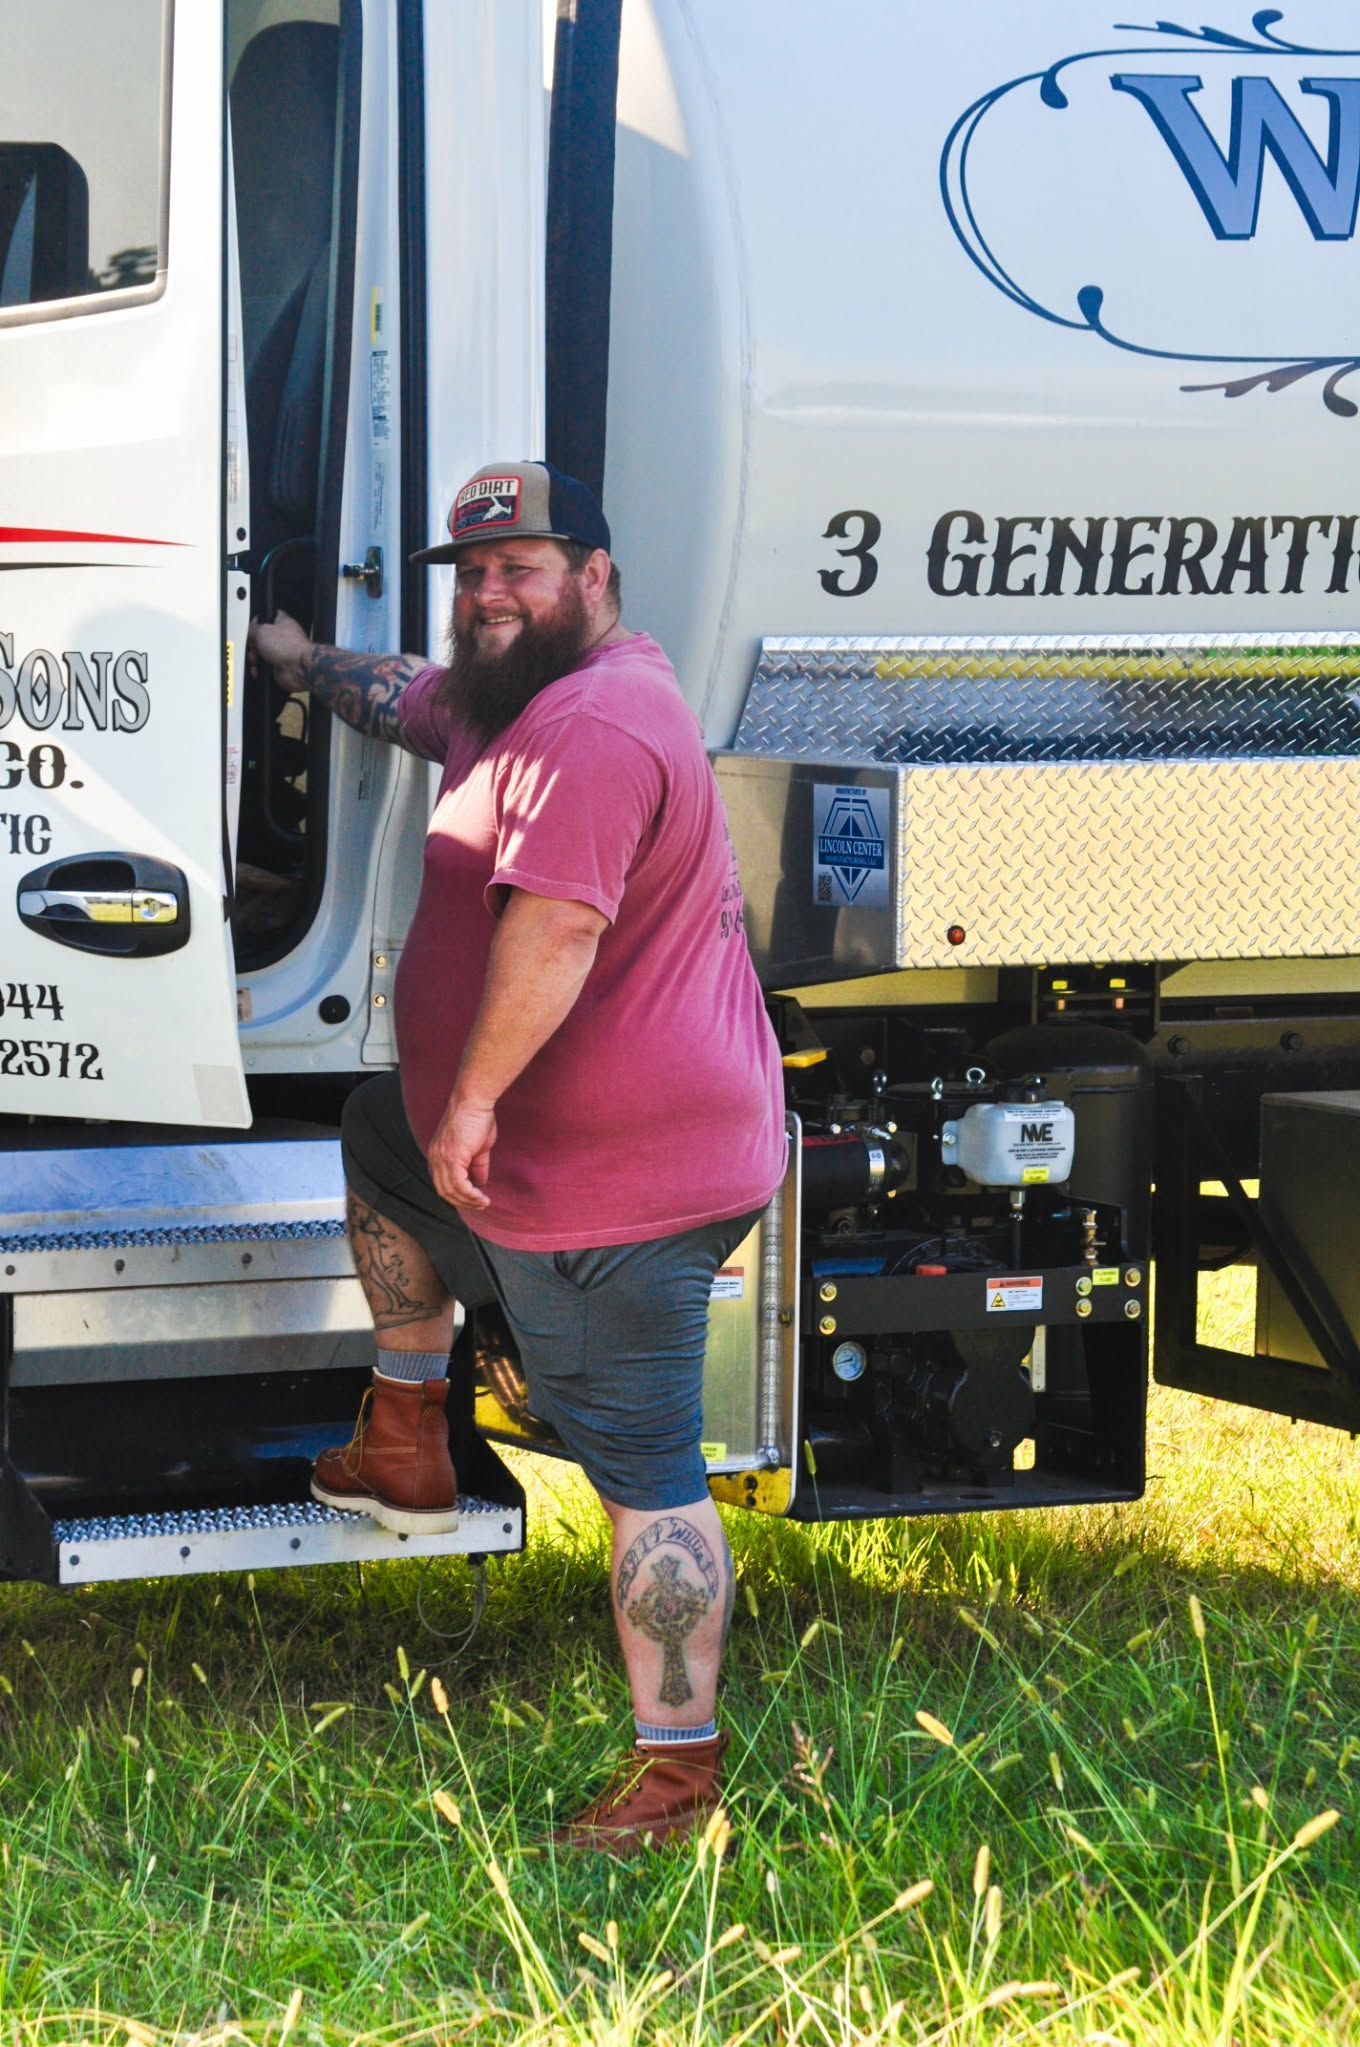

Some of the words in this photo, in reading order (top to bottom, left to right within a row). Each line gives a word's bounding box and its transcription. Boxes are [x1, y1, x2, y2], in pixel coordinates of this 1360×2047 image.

[479, 480, 514, 495] DIRT
[817, 510, 882, 597] 3
[926, 510, 1360, 597] GENERATI
[819, 838, 852, 855] LINCOLN
[853, 841, 882, 857] CENTER
[0, 983, 64, 1021] 44
[0, 1039, 104, 1080] 2572
[1021, 1122, 1054, 1143] NVE
